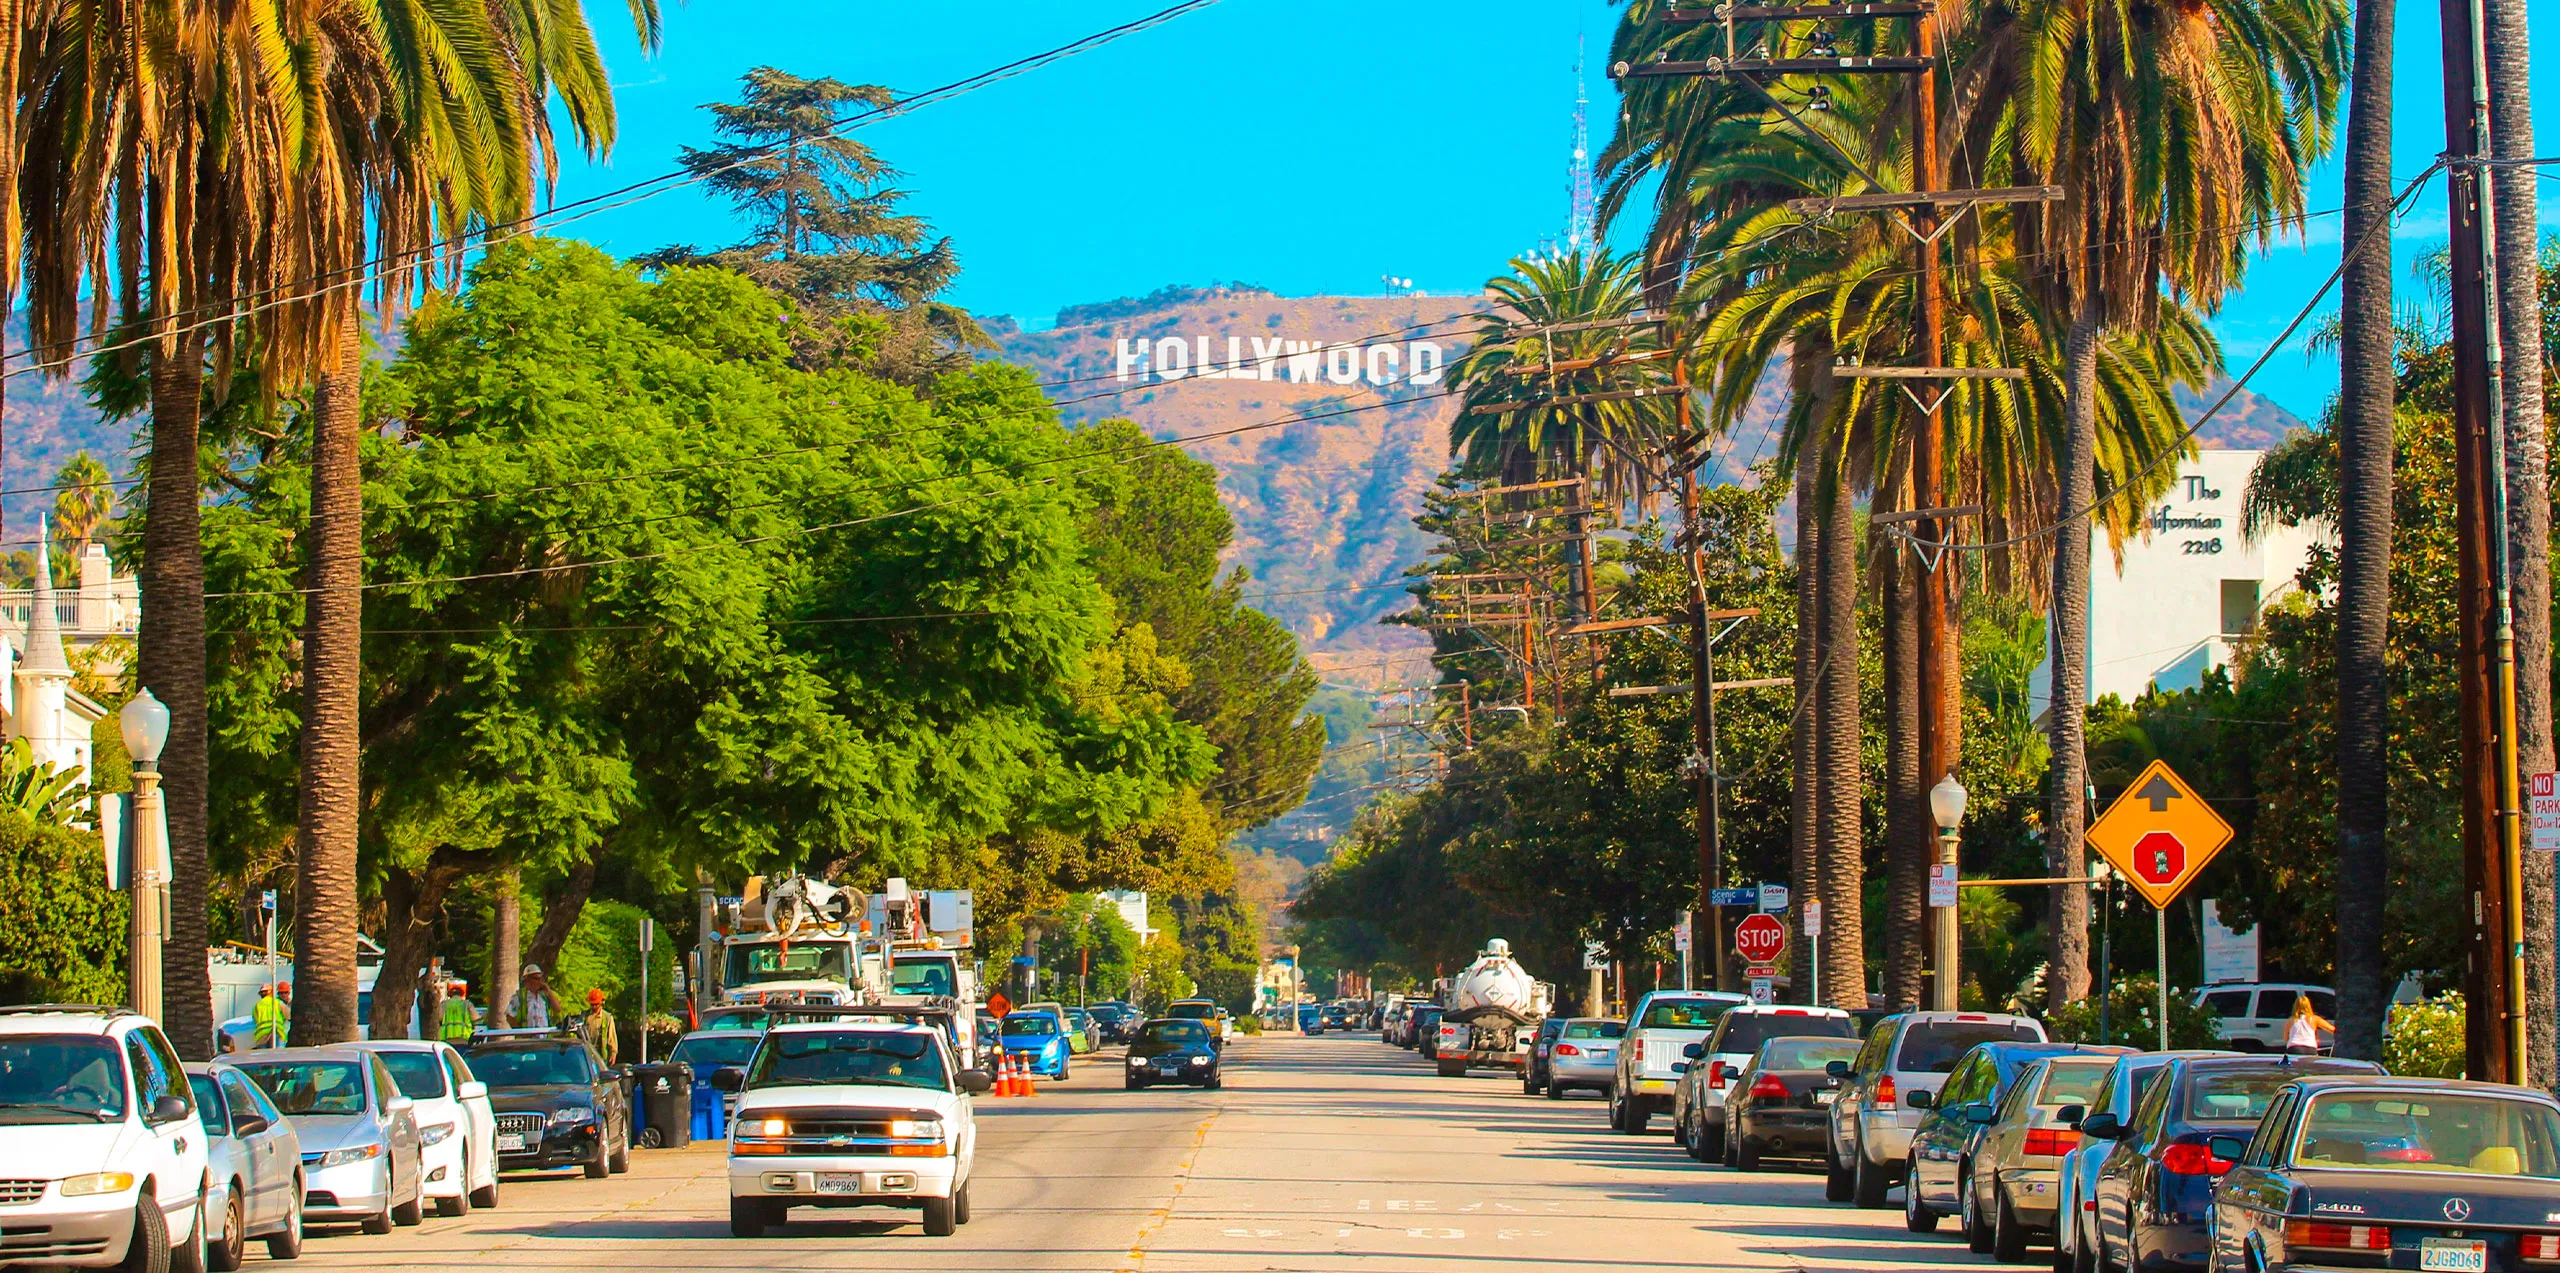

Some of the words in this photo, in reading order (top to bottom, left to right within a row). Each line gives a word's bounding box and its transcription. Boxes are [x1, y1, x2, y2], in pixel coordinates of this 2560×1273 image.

[1117, 336, 1442, 386] HOLLYWOOD
[2181, 475, 2221, 503] The
[2150, 505, 2222, 535] lifornian
[2181, 538, 2222, 555] 2218
[2534, 776, 2551, 794] NO
[2534, 816, 2560, 829] 10AM-1
[1931, 866, 1941, 876] NO
[1711, 889, 1737, 899] Scenic
[1740, 929, 1781, 947] STOP
[820, 1181, 857, 1191] 6M09869
[2424, 1250, 2481, 1268] 2JGB068
